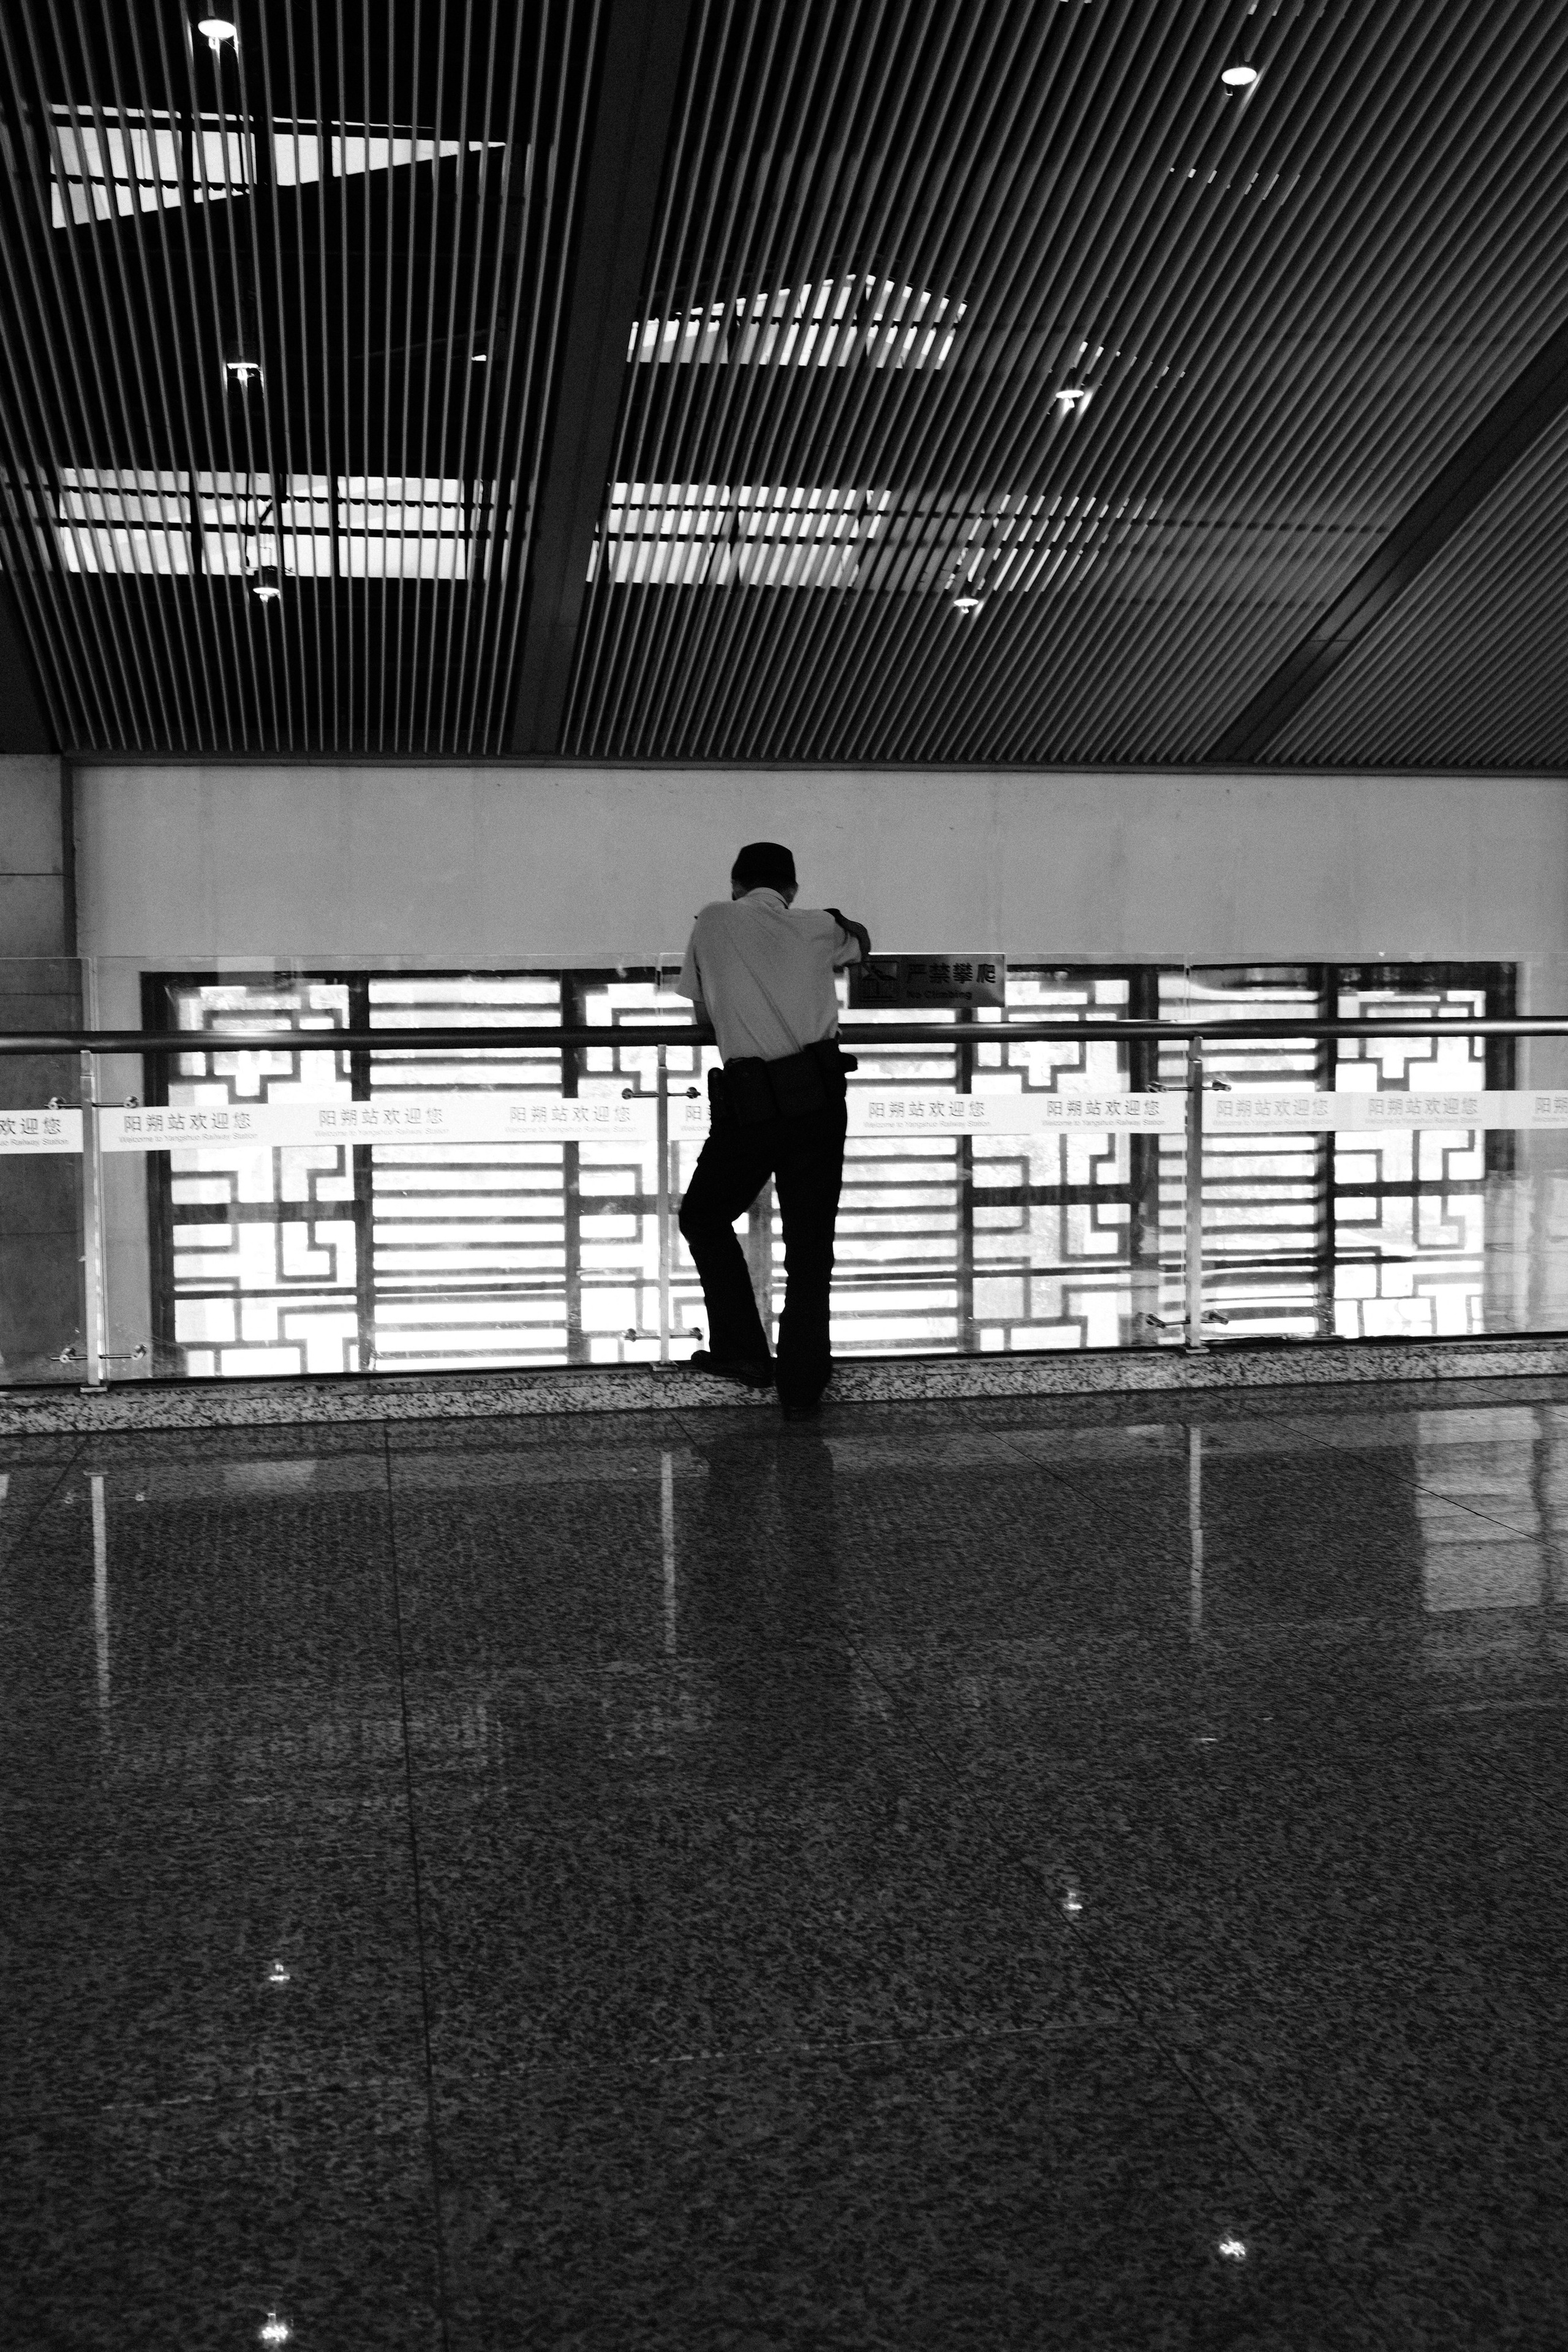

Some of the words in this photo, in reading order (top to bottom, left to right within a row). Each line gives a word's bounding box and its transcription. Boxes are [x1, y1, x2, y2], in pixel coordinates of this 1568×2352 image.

[907, 962, 996, 984] 严禁攀爬
[510, 1105, 631, 1123] 阳朔站欢迎您
[869, 1101, 985, 1118] 阳朔站欢迎您
[1047, 1099, 1159, 1117] 阳朔站欢迎您
[1216, 1099, 1329, 1117] 阳朔站欢迎您
[1368, 1098, 1477, 1115] 阳朔站欢迎您
[124, 1112, 251, 1133] 阳朔站欢迎您
[318, 1107, 443, 1128] 阳朔站欢迎您
